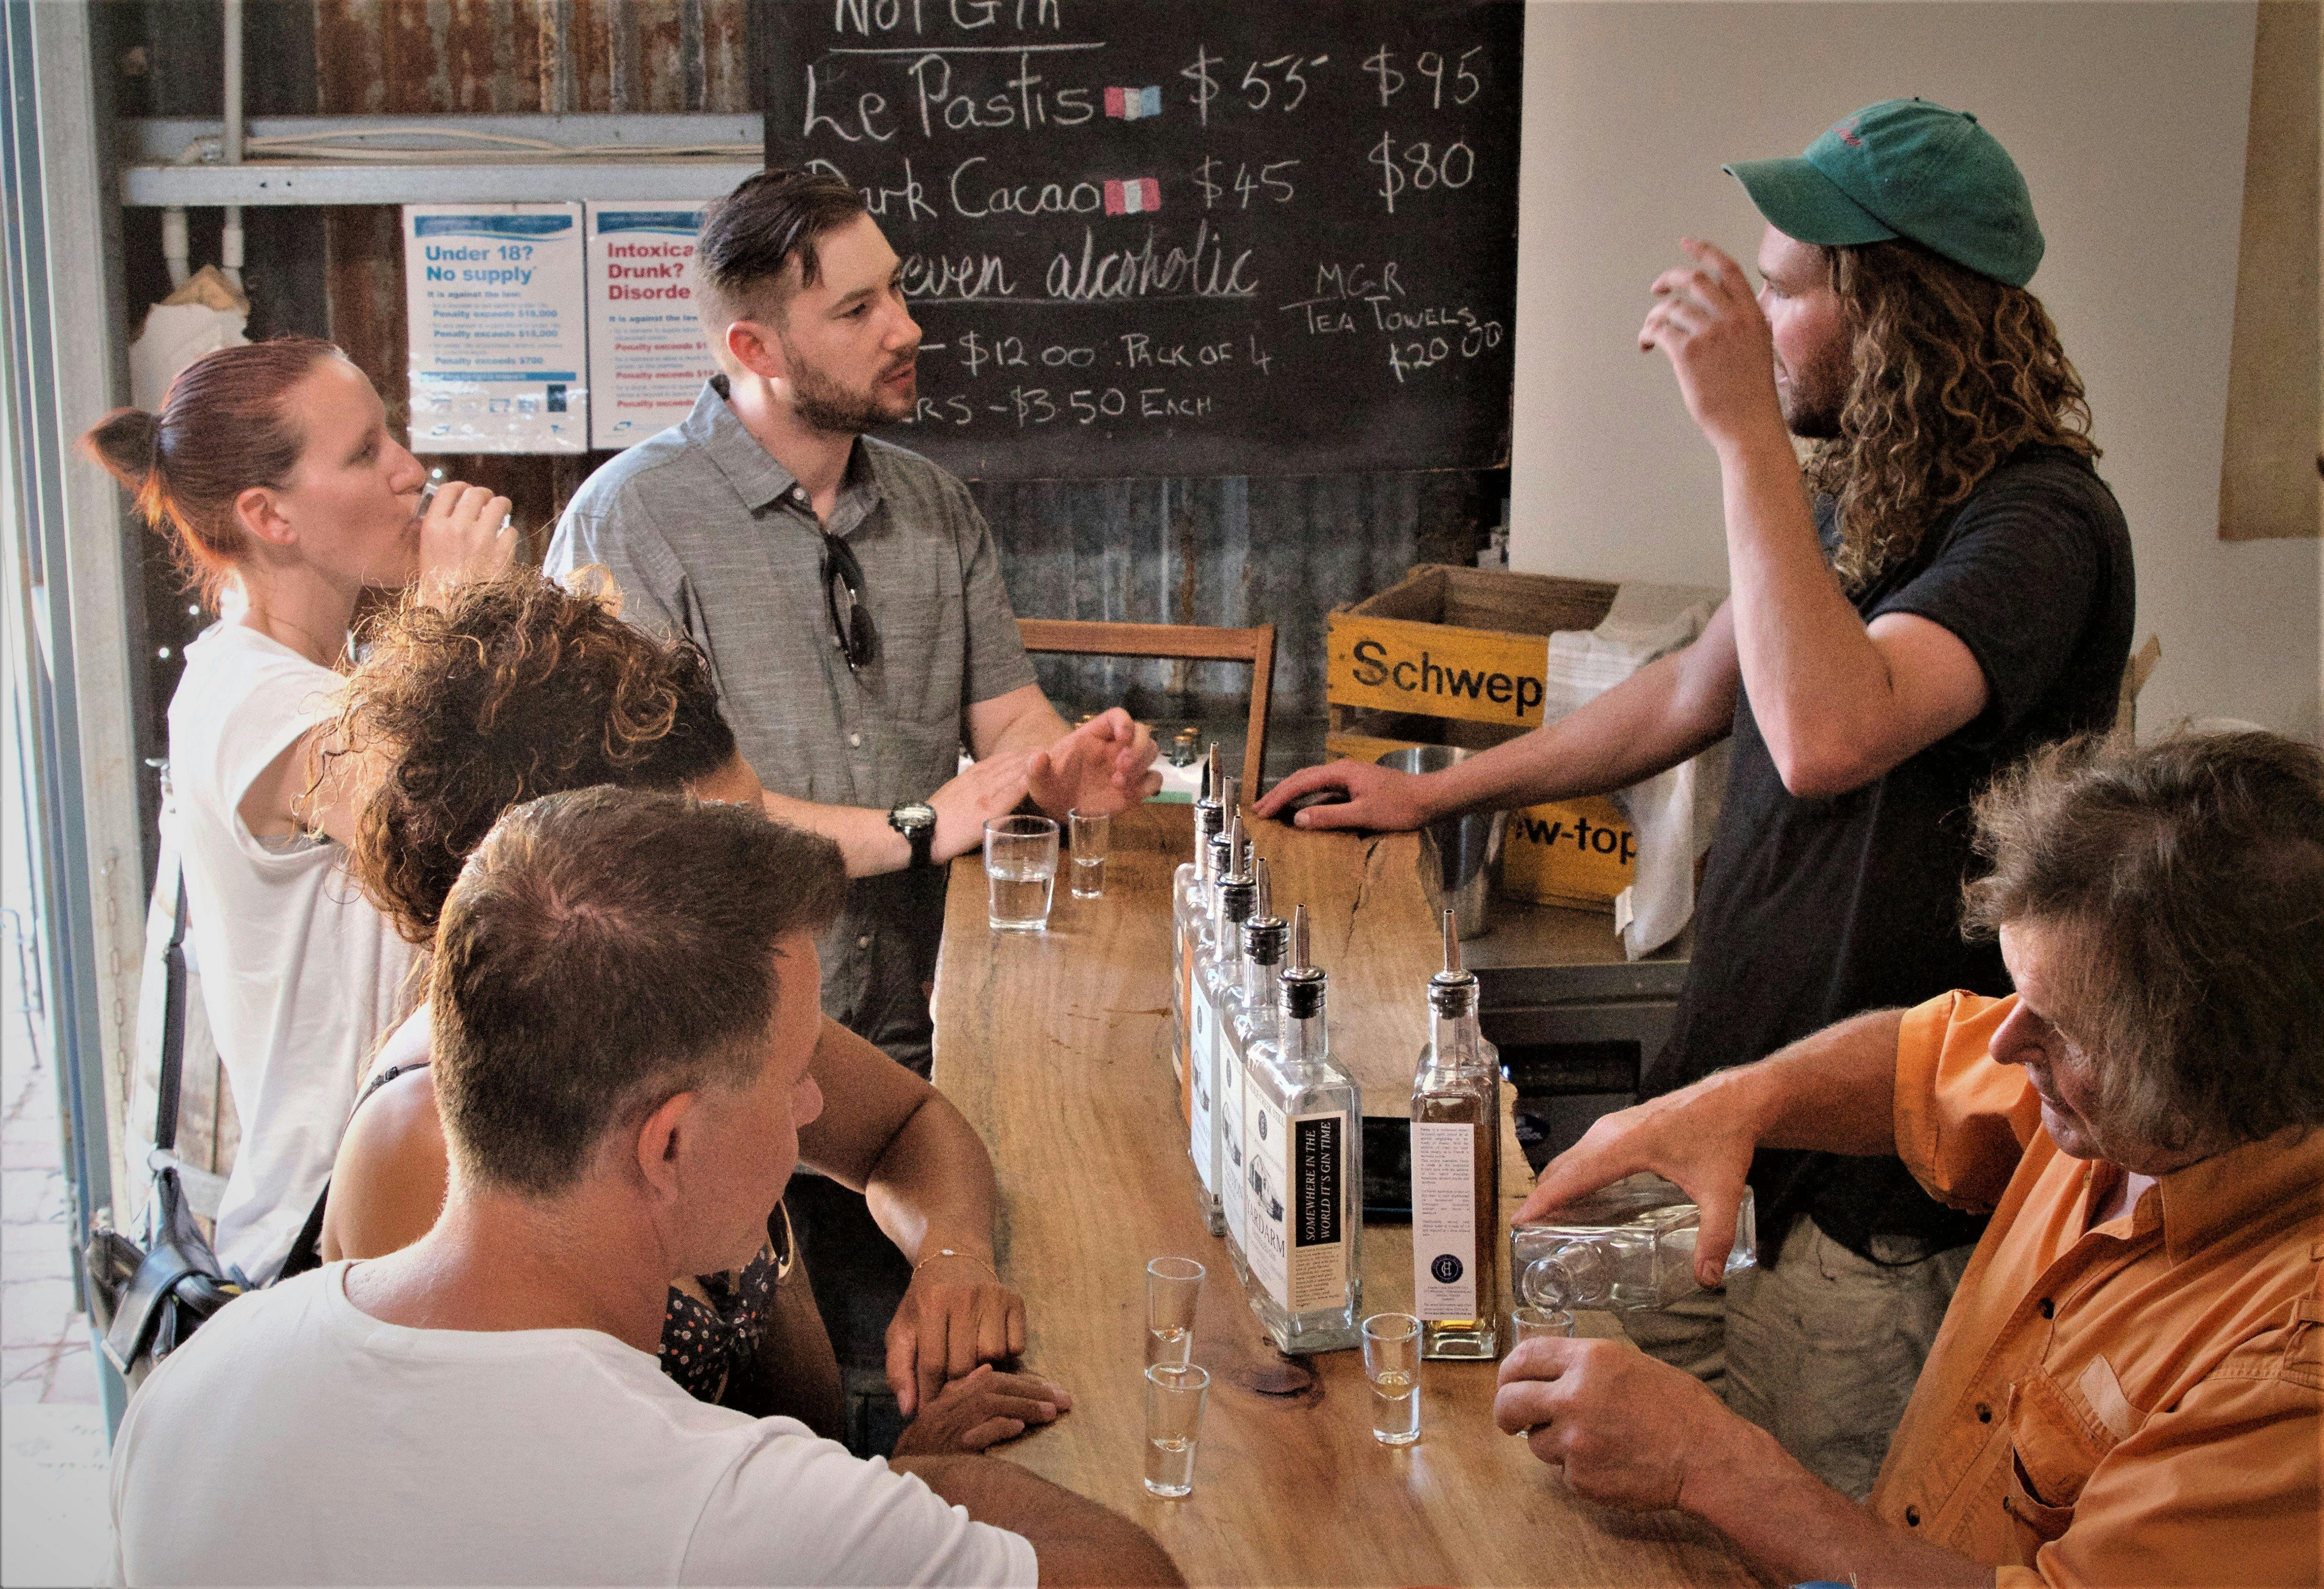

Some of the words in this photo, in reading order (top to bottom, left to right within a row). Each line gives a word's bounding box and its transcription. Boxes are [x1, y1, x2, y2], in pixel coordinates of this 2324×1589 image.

[1363, 43, 1484, 110] $95
[803, 65, 898, 142] Le
[908, 52, 1094, 138] Pastis
[951, 157, 1100, 217] Cacao
[1192, 156, 1300, 208] $45
[1368, 131, 1474, 214] $80
[425, 245, 490, 261] Under
[498, 245, 534, 261] 18?
[609, 262, 684, 278] Drunk?
[901, 254, 1017, 299] even
[1047, 220, 1259, 300] alcoholic
[426, 266, 456, 281] No
[463, 266, 532, 285] supply
[609, 284, 691, 300] Disorde
[1251, 334, 1272, 376] 4
[1142, 388, 1212, 417] EACH
[1352, 640, 1543, 716] Schwep
[1516, 817, 1636, 865] w-top
[1306, 1130, 1315, 1153] THE
[1321, 1122, 1330, 1149] TIME
[1306, 1155, 1315, 1166] IN
[1321, 1152, 1330, 1173] GIN
[1306, 1170, 1315, 1241] SOMEWHERE
[1321, 1175, 1330, 1196] IT'S
[1321, 1198, 1330, 1238] WORLD
